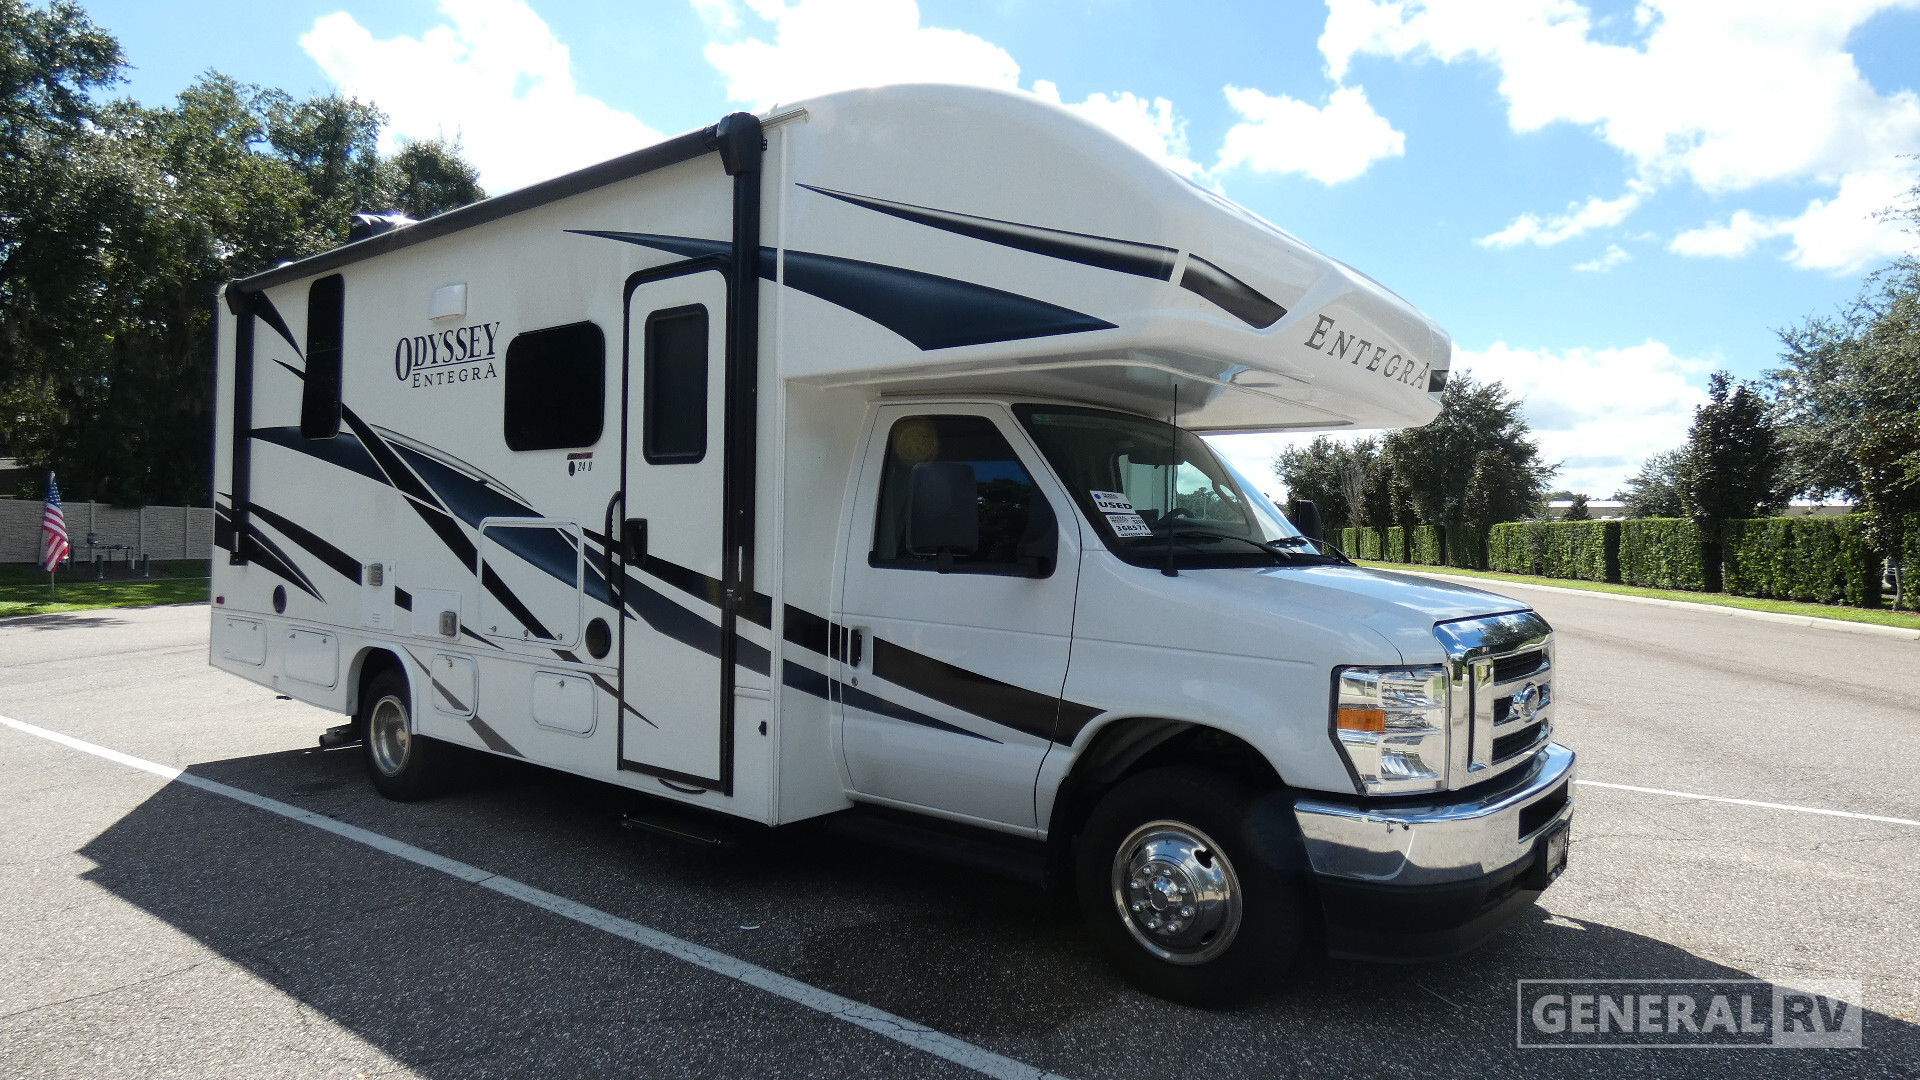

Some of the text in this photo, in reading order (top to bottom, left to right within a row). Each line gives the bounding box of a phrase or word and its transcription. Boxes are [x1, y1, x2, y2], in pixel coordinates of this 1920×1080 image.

[396, 322, 500, 381] ODYSSEY
[1303, 314, 1430, 389] ENTEGRA
[412, 363, 497, 388] ENTEGRA
[1098, 501, 1133, 510] USED
